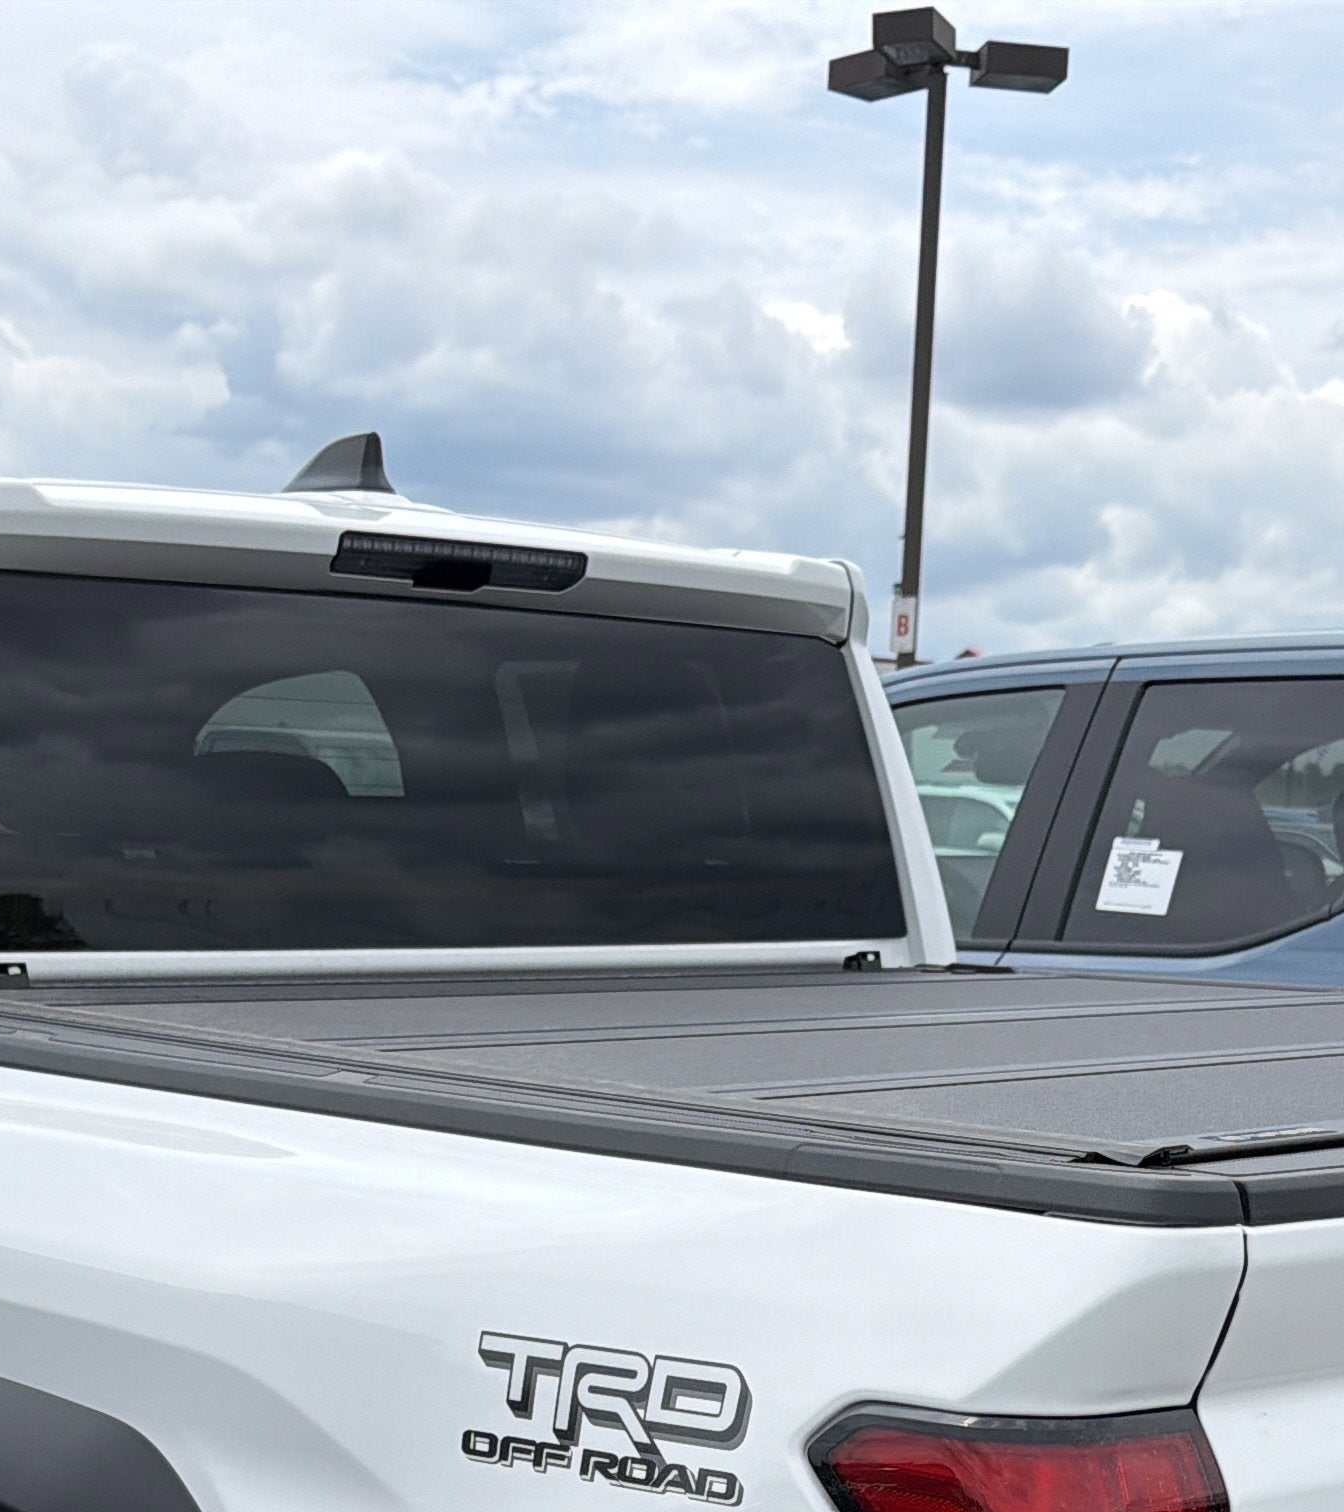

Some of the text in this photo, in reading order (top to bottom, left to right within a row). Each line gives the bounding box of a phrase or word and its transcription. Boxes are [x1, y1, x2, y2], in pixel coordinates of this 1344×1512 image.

[478, 1330, 753, 1462] TRD
[461, 1429, 745, 1507] OFF ROAD
